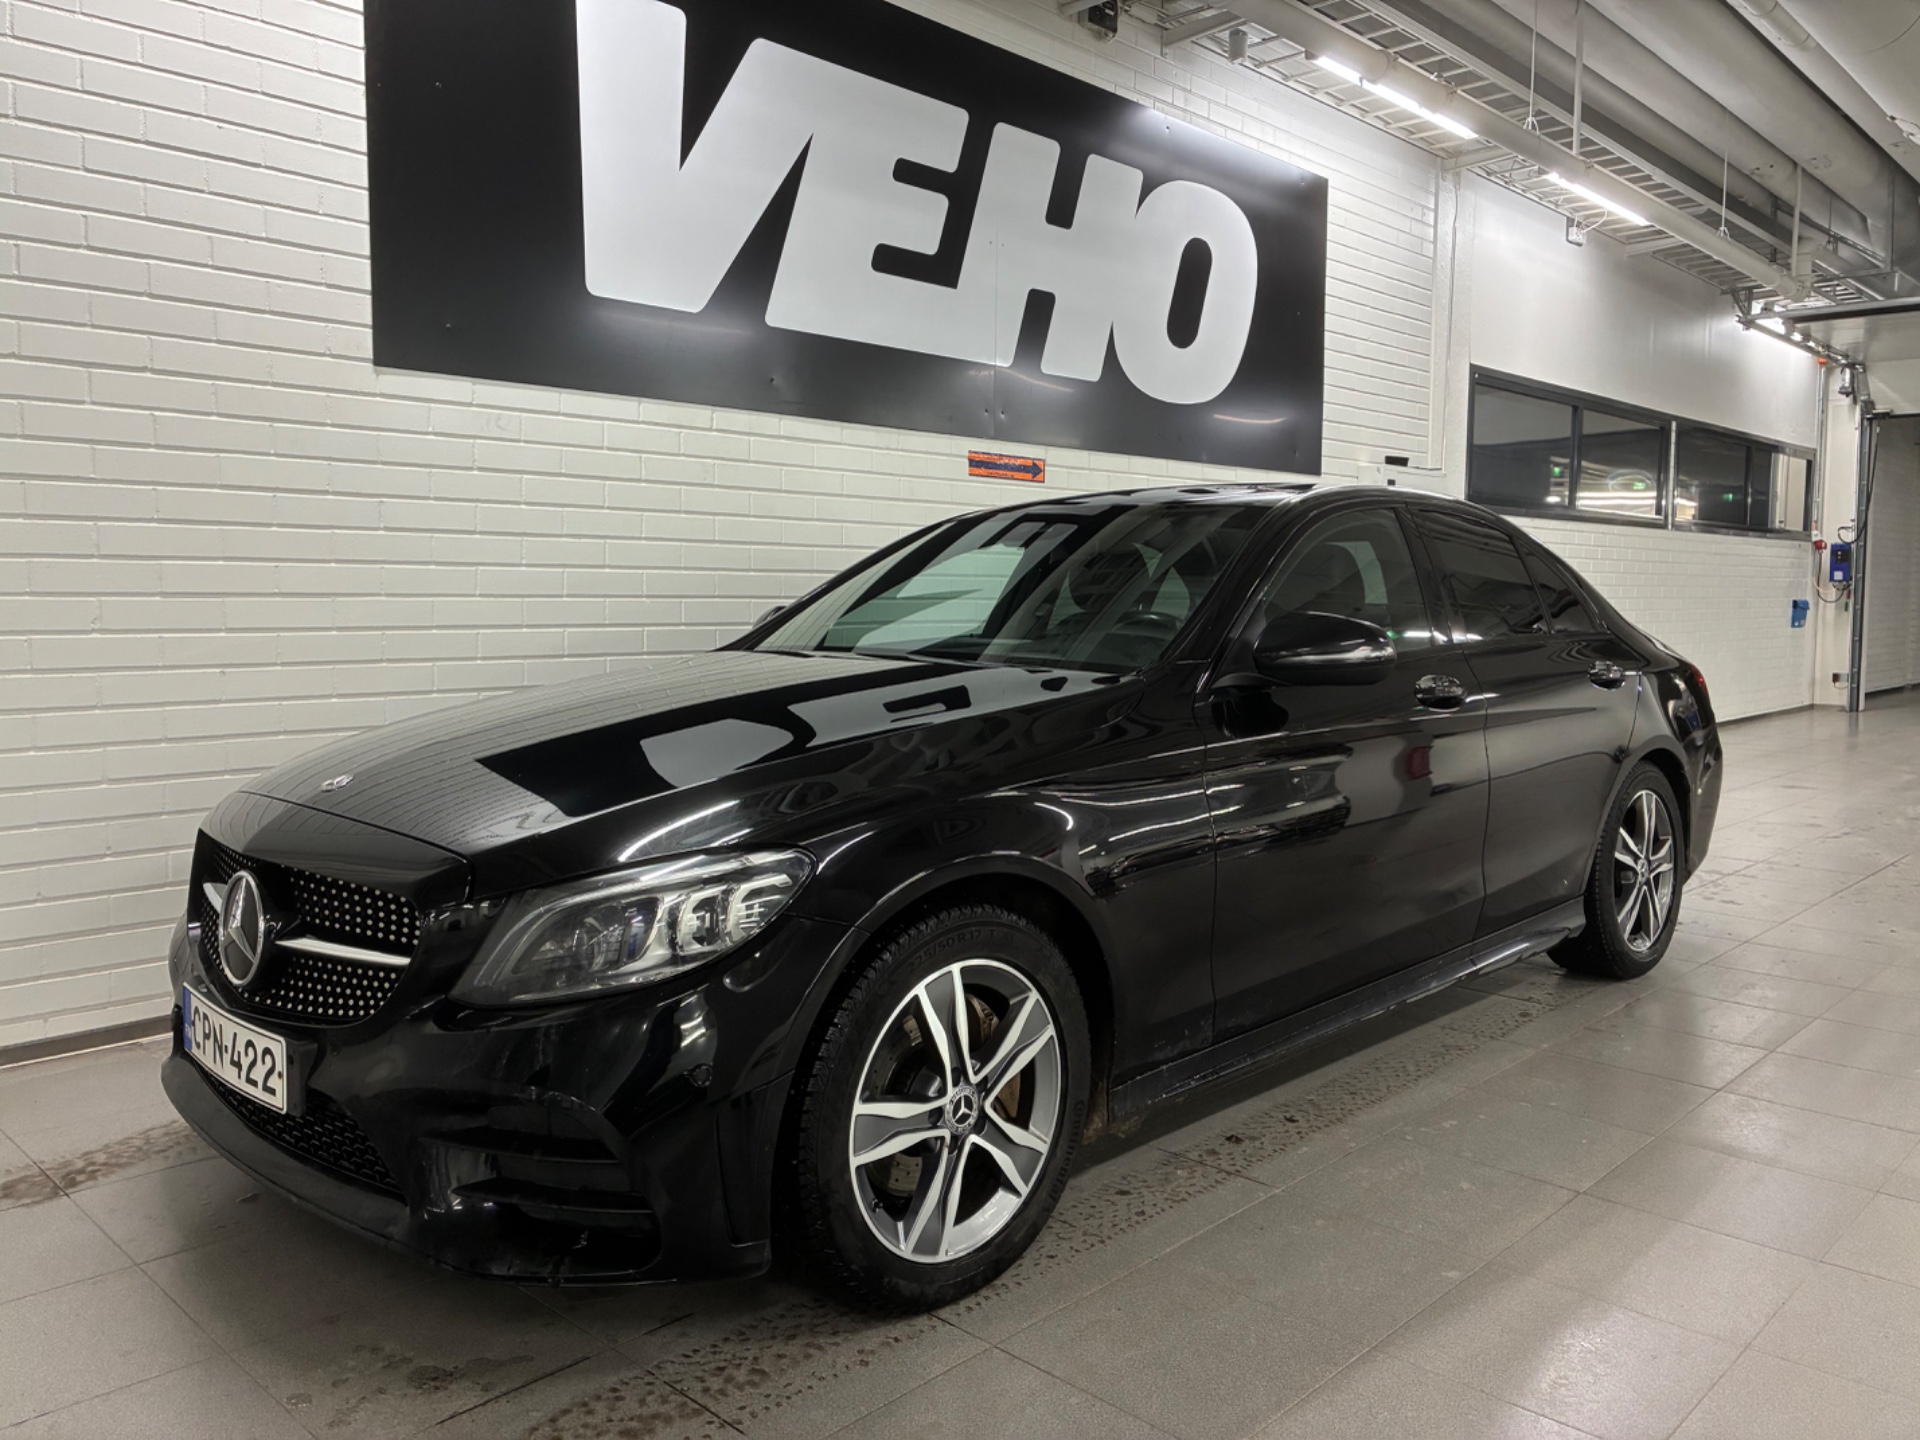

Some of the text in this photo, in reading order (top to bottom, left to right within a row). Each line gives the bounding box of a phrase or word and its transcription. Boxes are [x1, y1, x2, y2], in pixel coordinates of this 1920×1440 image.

[576, 0, 1258, 404] VEHO
[193, 1006, 276, 1096] CPN-422
[1048, 1100, 1085, 1202] Continental
